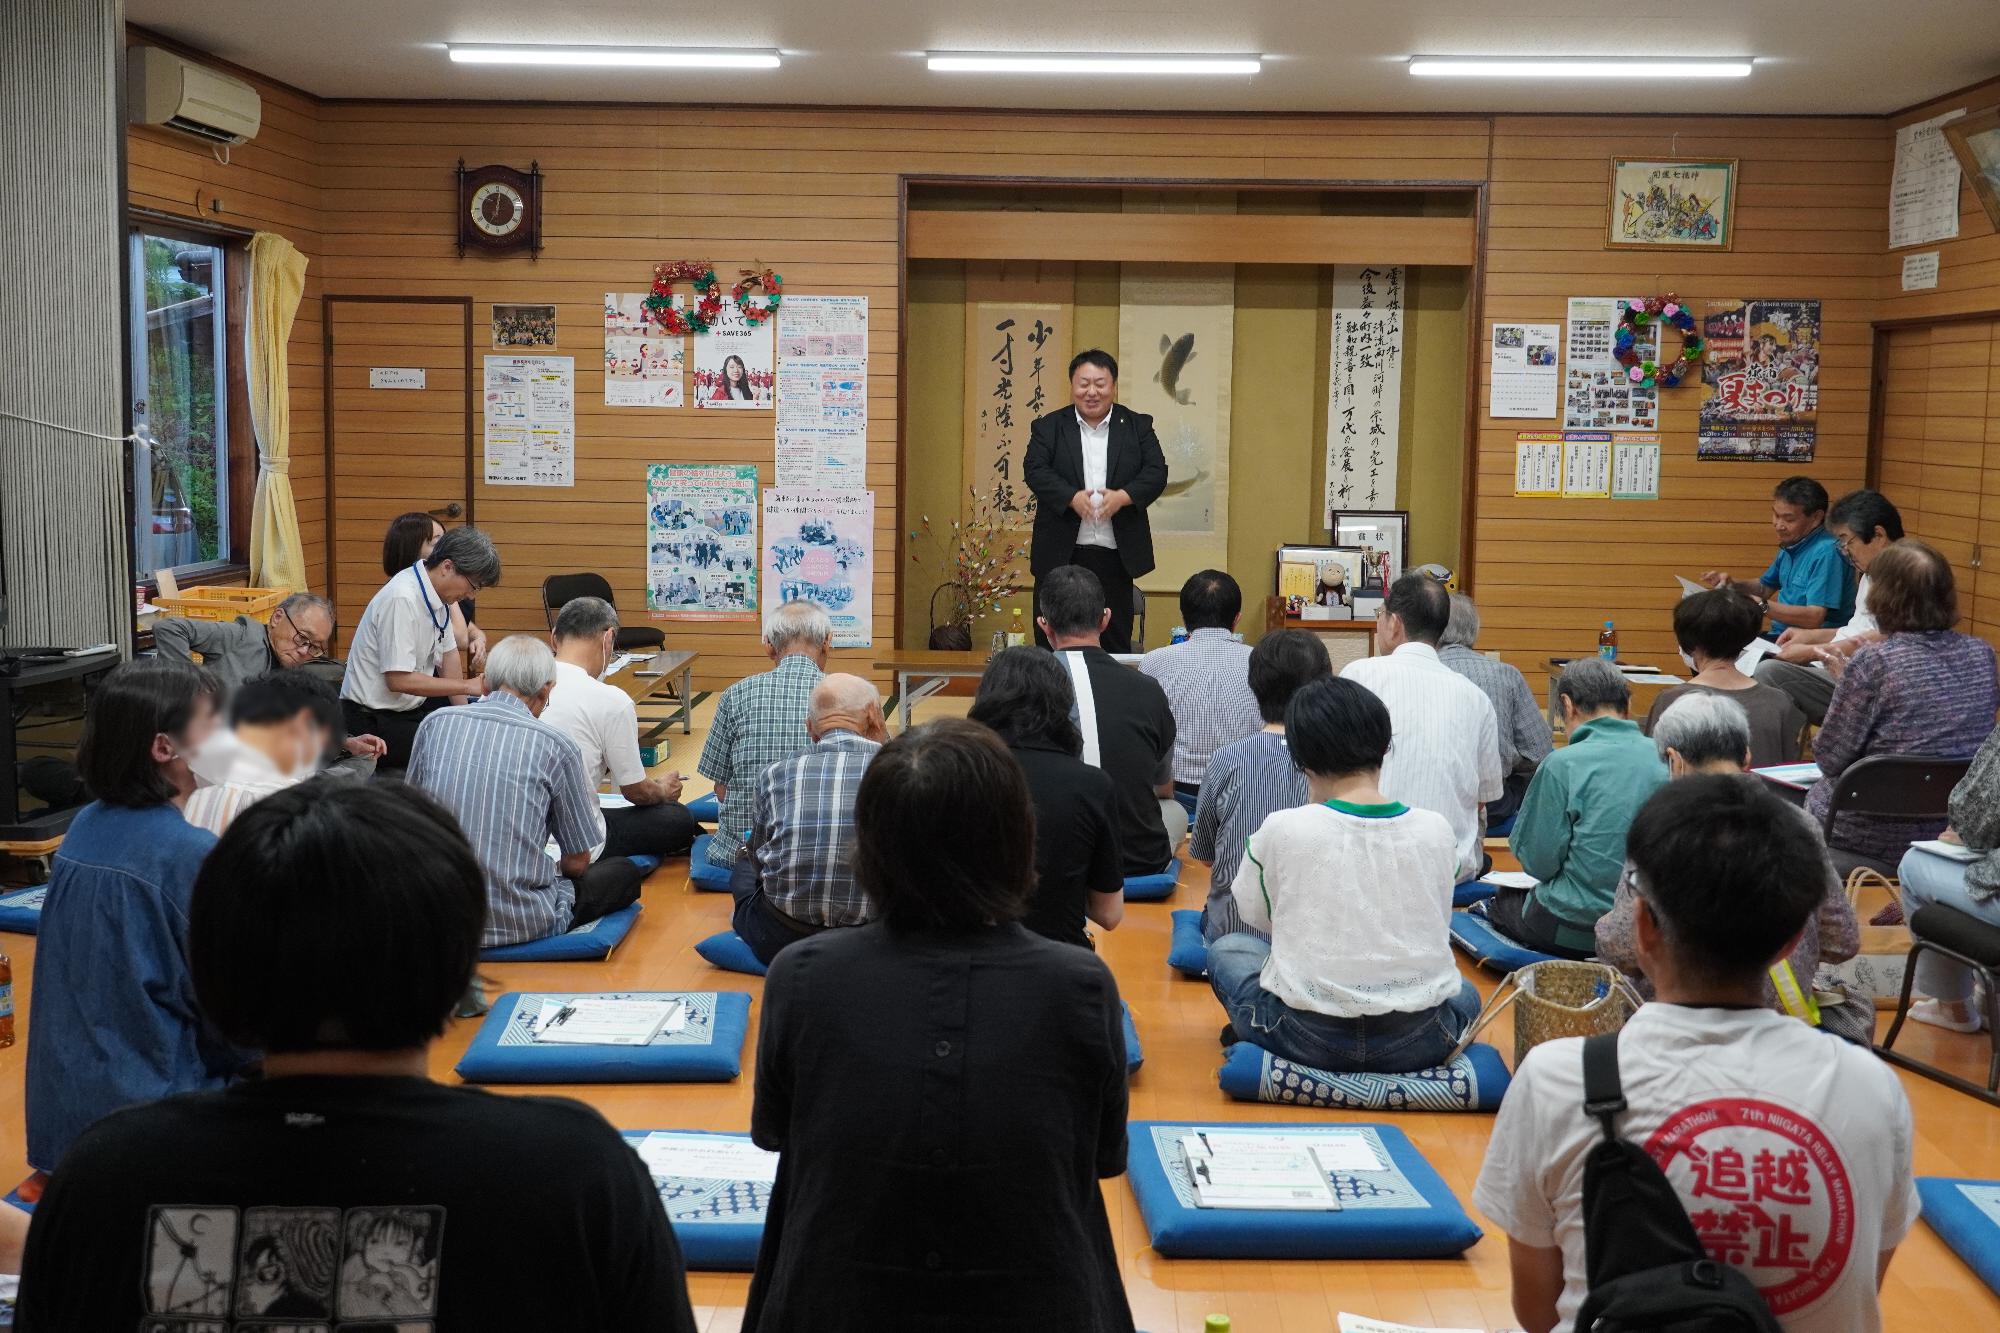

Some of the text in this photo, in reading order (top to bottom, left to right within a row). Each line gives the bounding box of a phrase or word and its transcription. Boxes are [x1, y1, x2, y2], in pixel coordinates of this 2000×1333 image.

[1719, 376, 1803, 412] 夏まつり
[1690, 1147, 1811, 1206] 追越
[1739, 1107, 1846, 1246] 7th NIIGATA RELAY MARATHON
[1690, 1208, 1811, 1270] 禁止
